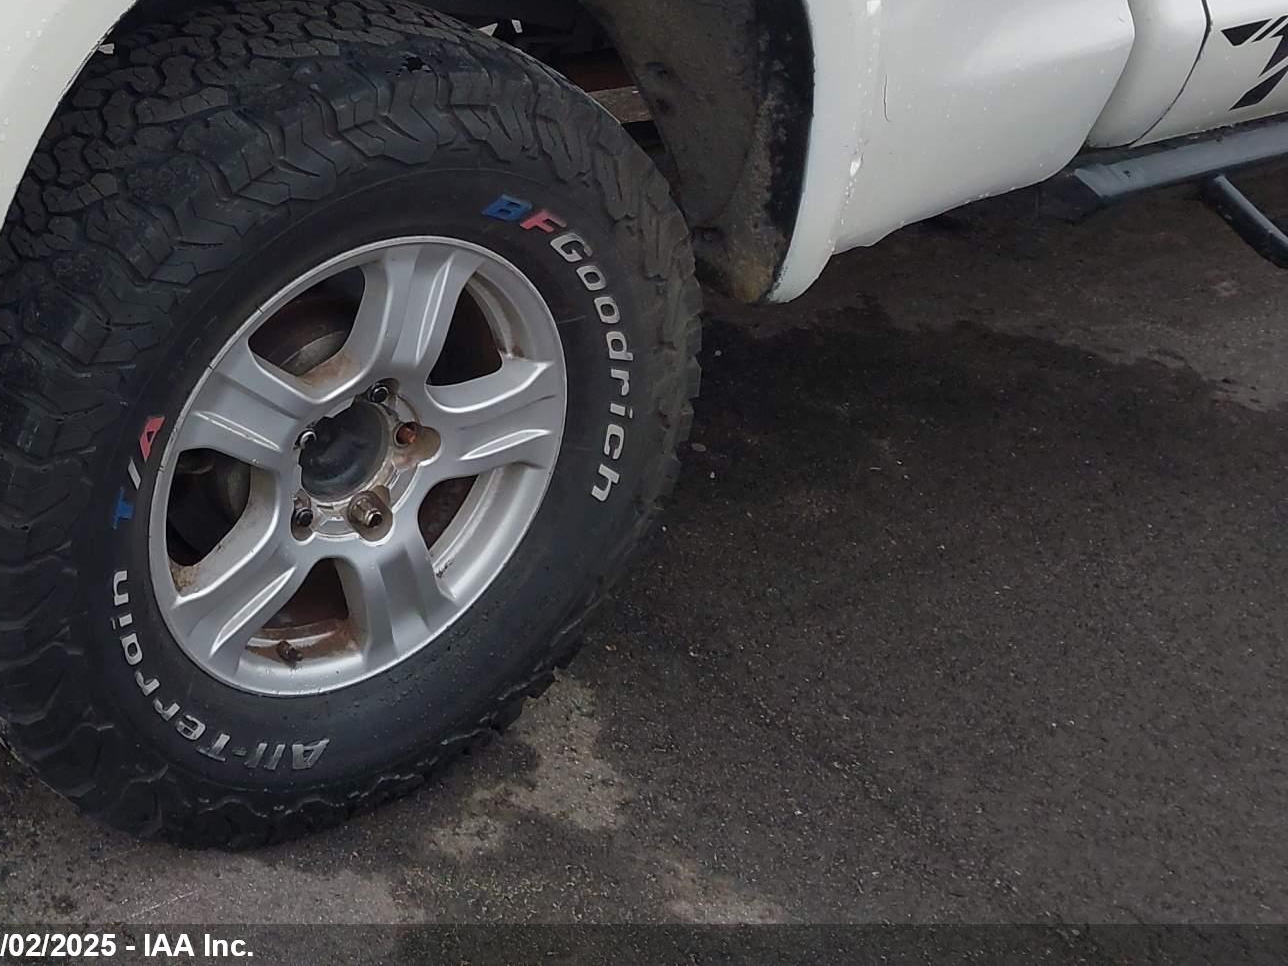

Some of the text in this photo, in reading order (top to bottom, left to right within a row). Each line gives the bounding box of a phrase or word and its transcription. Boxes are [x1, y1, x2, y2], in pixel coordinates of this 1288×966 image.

[481, 194, 634, 502] BFGoodrich
[110, 416, 331, 770] All-Terrain T/A
